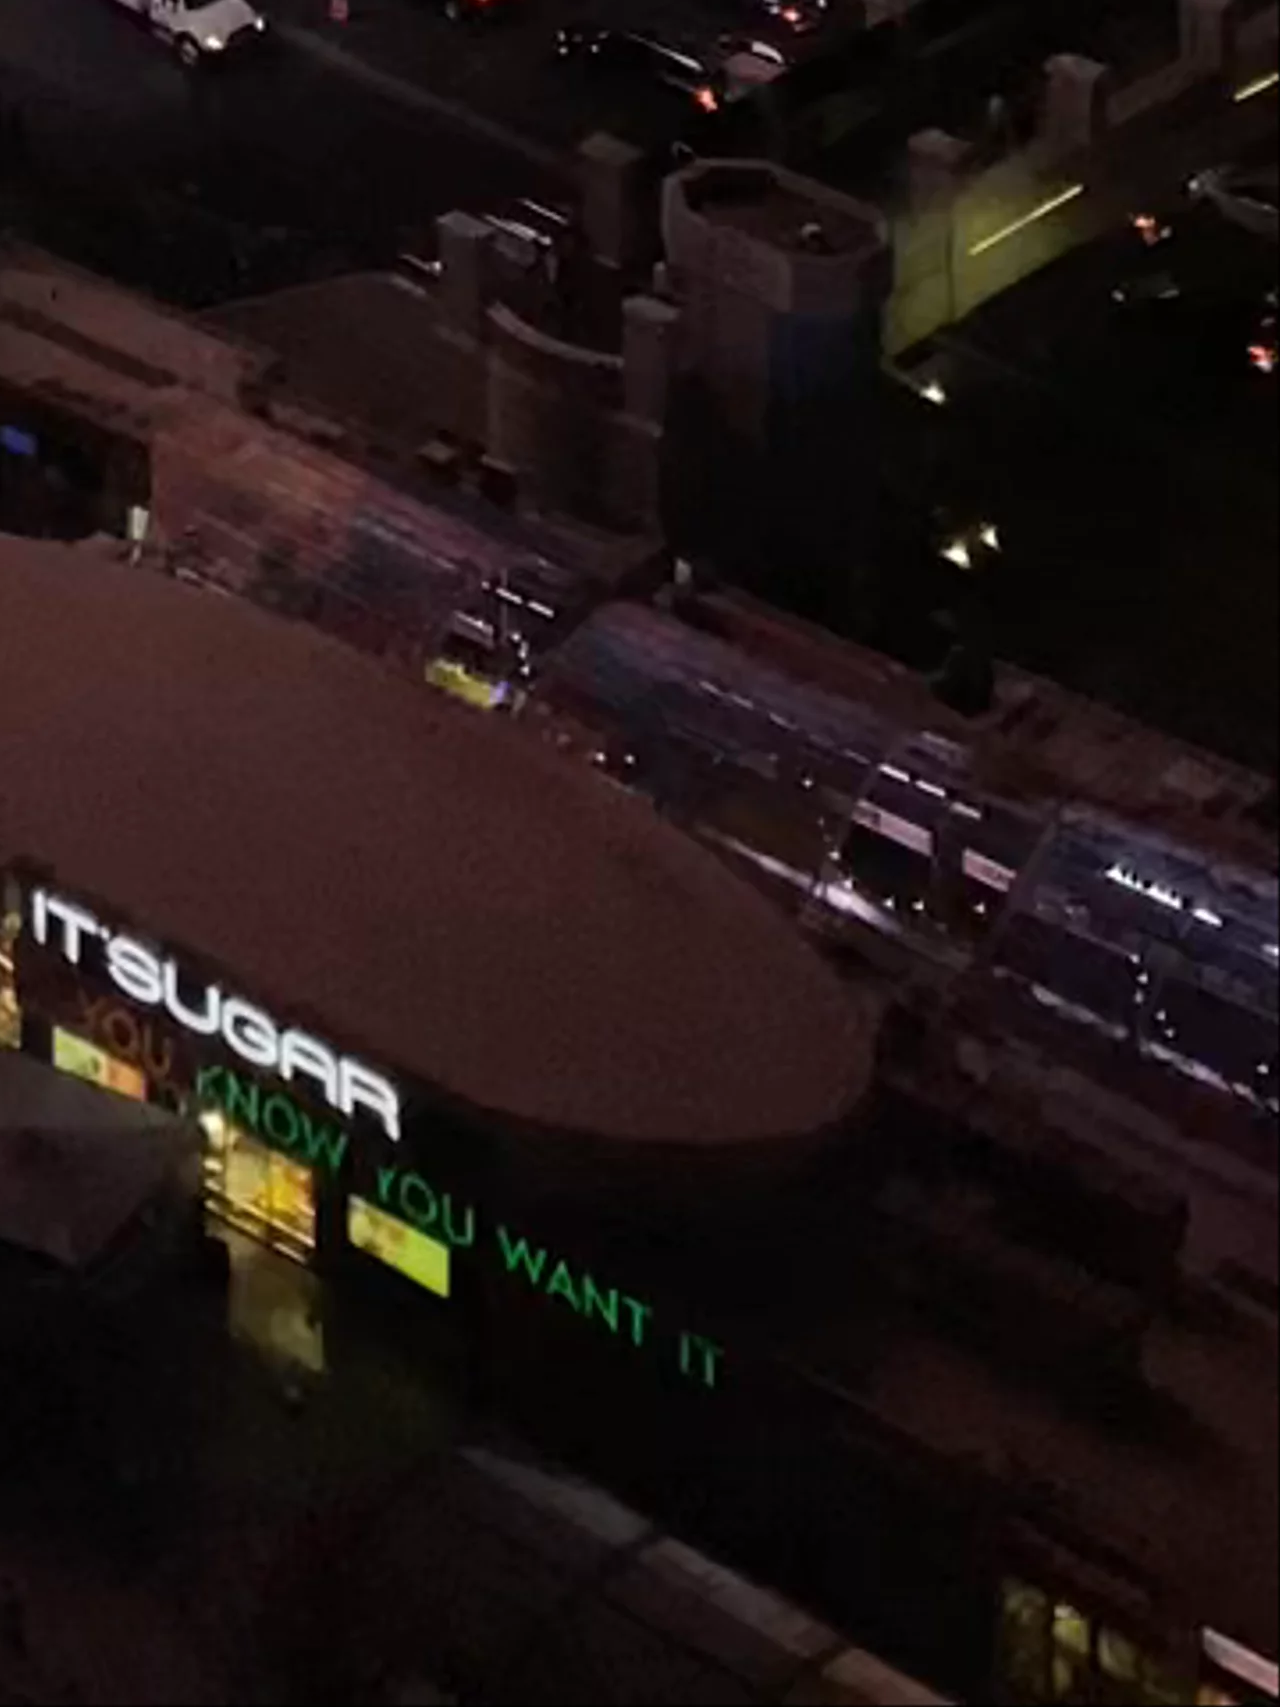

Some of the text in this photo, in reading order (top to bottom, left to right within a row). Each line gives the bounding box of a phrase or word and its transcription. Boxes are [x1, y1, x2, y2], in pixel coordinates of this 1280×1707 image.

[31, 888, 402, 1143] IT'SUGAR
[196, 1064, 349, 1174] KNOW
[378, 1164, 474, 1247] YOU
[496, 1225, 652, 1348] WANT
[679, 1329, 725, 1388] IT
